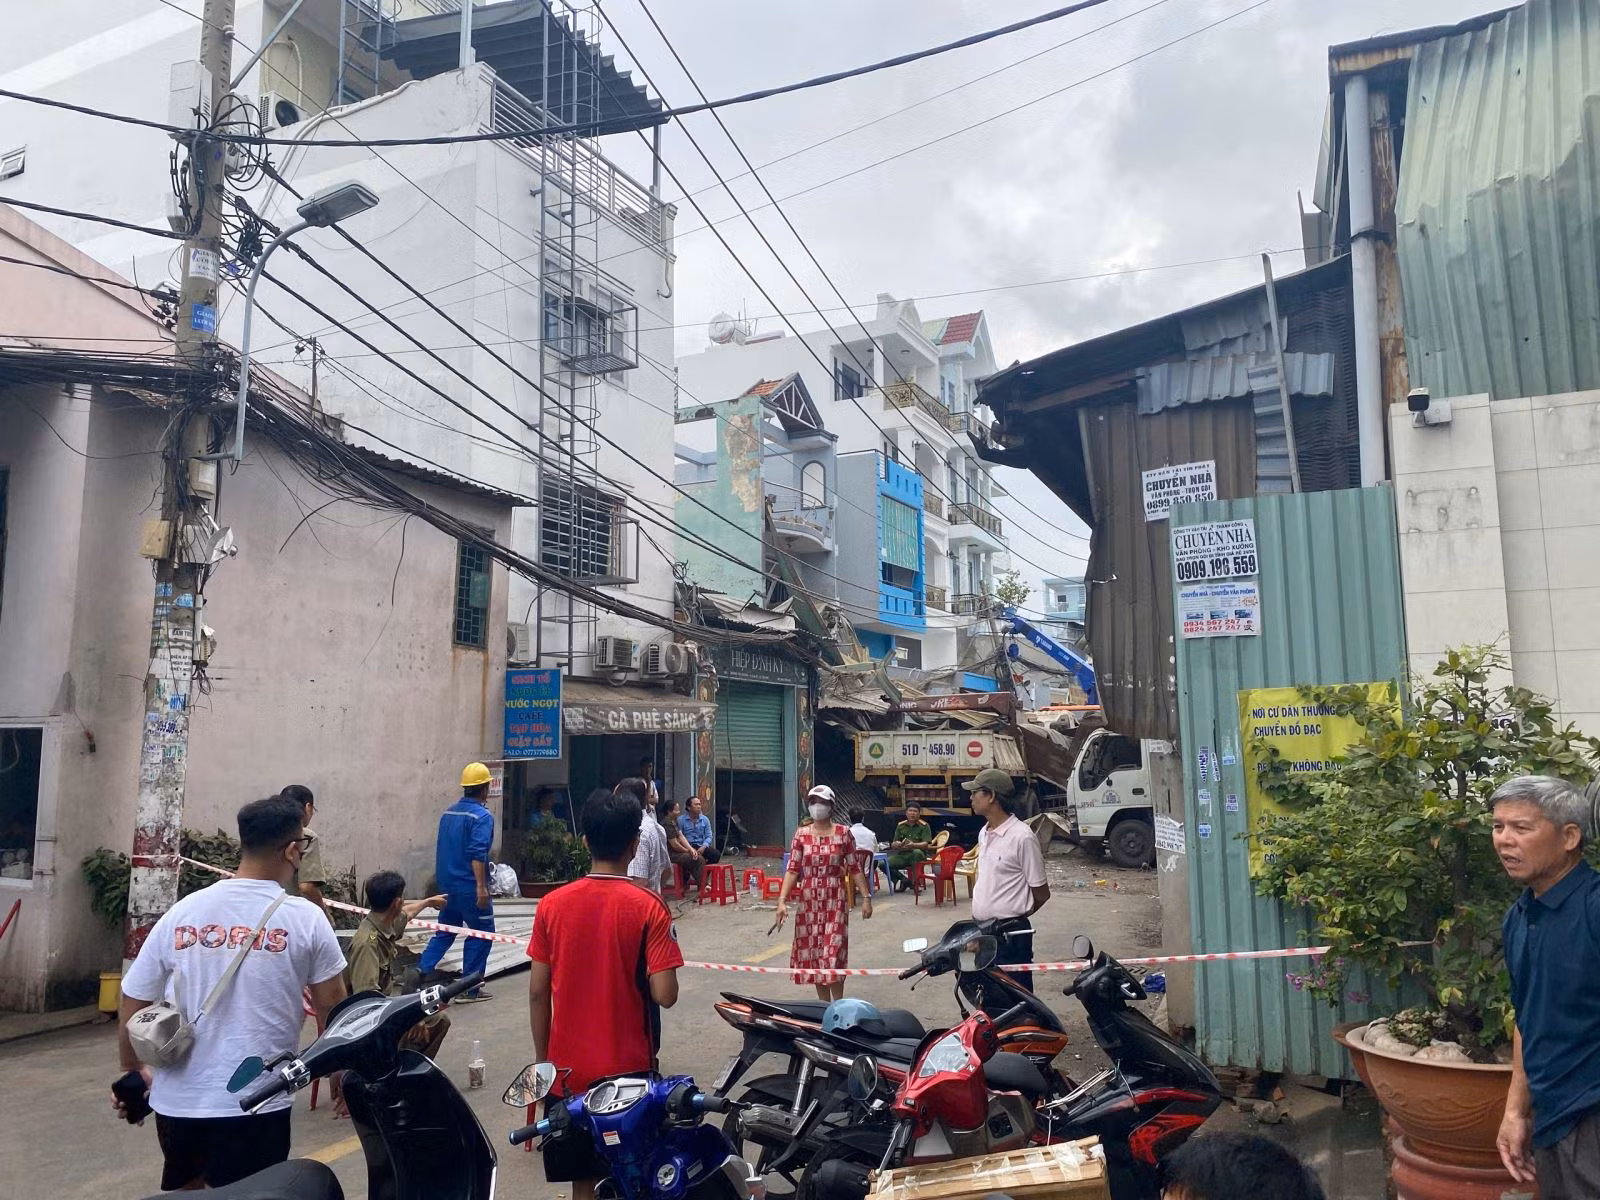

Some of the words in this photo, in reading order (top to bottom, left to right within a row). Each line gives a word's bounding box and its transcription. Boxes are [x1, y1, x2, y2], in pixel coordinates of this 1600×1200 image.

[1190, 470, 1213, 486] NHÀ
[1146, 498, 1170, 510] 0899
[1225, 523, 1253, 544] NHÀ
[532, 699, 560, 710] NGỌT
[608, 707, 629, 729] CÀ
[632, 707, 661, 729] PHÊ
[902, 744, 919, 756] 51D
[929, 743, 955, 756] 458.90
[1292, 758, 1322, 772] KHÔNG
